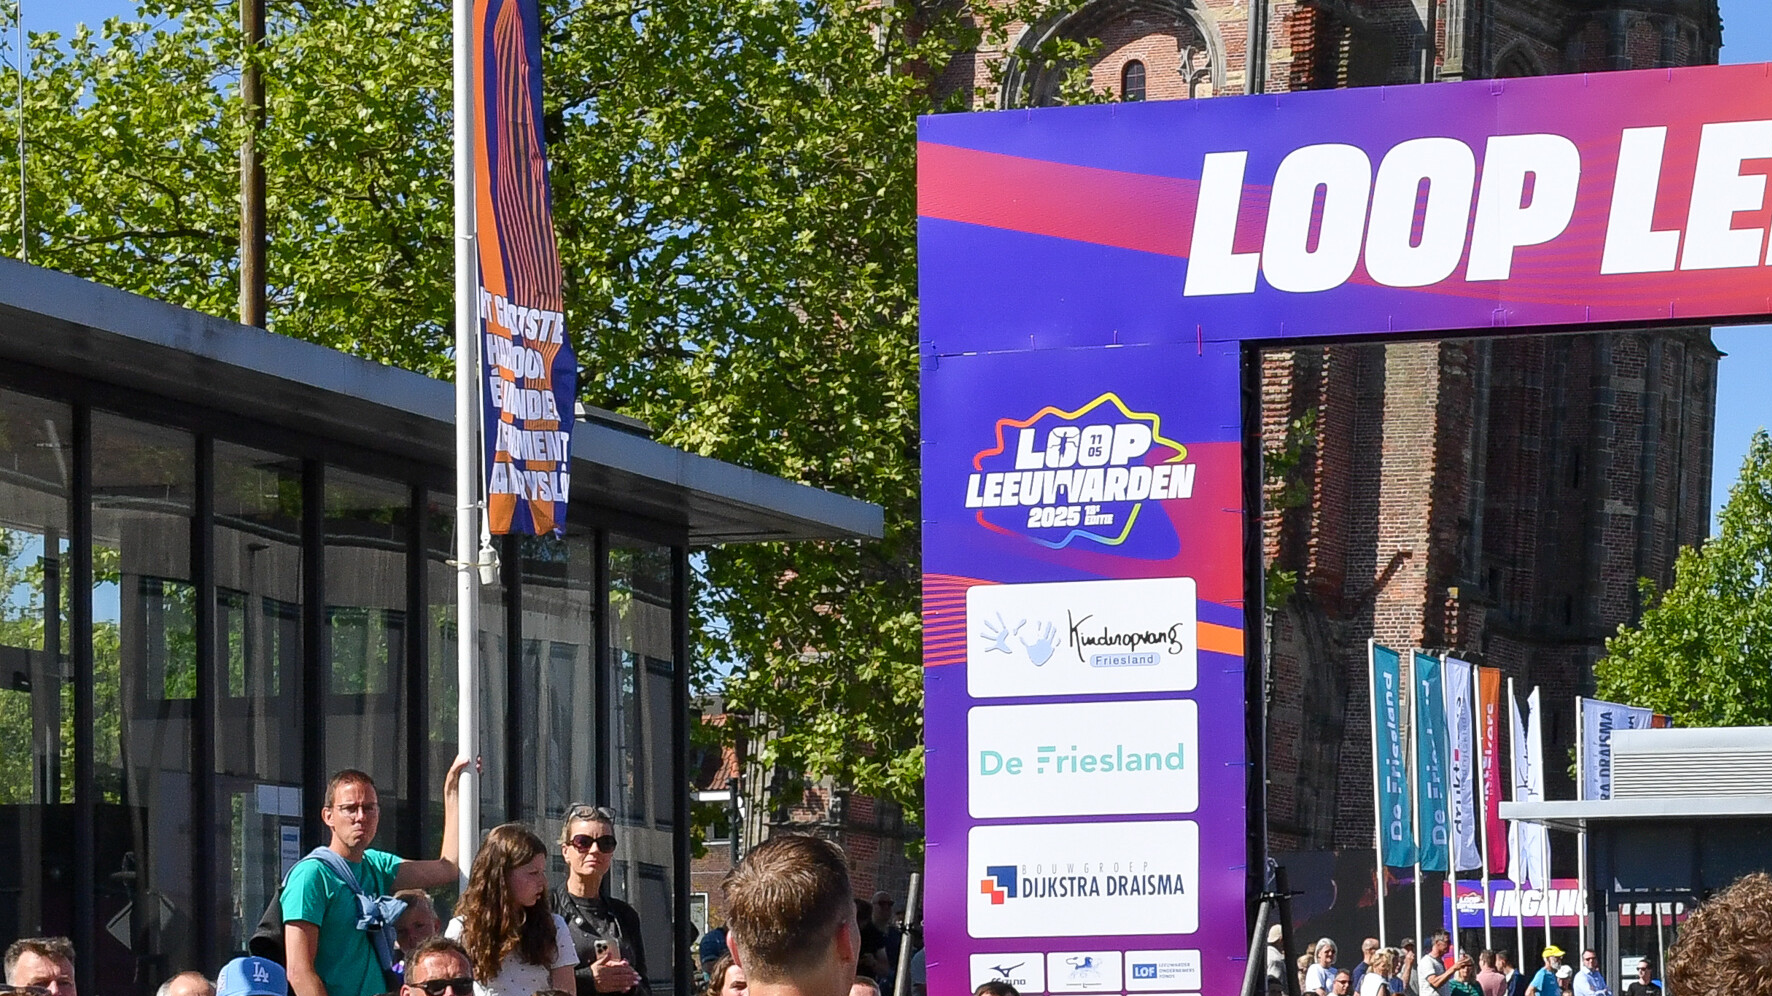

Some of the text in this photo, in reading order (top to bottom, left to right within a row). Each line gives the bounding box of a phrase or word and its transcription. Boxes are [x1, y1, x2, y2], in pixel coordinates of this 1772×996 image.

[1184, 133, 1581, 297] LOOP
[1015, 423, 1153, 471] LOOP
[965, 464, 1196, 508] LEEUWARDEN
[1027, 505, 1082, 528] 2025
[1067, 609, 1184, 663] Kinderopvang
[1095, 654, 1154, 665] Friesland
[980, 743, 1184, 776] De Friesland
[1022, 874, 1185, 899] DIJKSTRA DRAISMA
[1134, 966, 1156, 978] LOF
